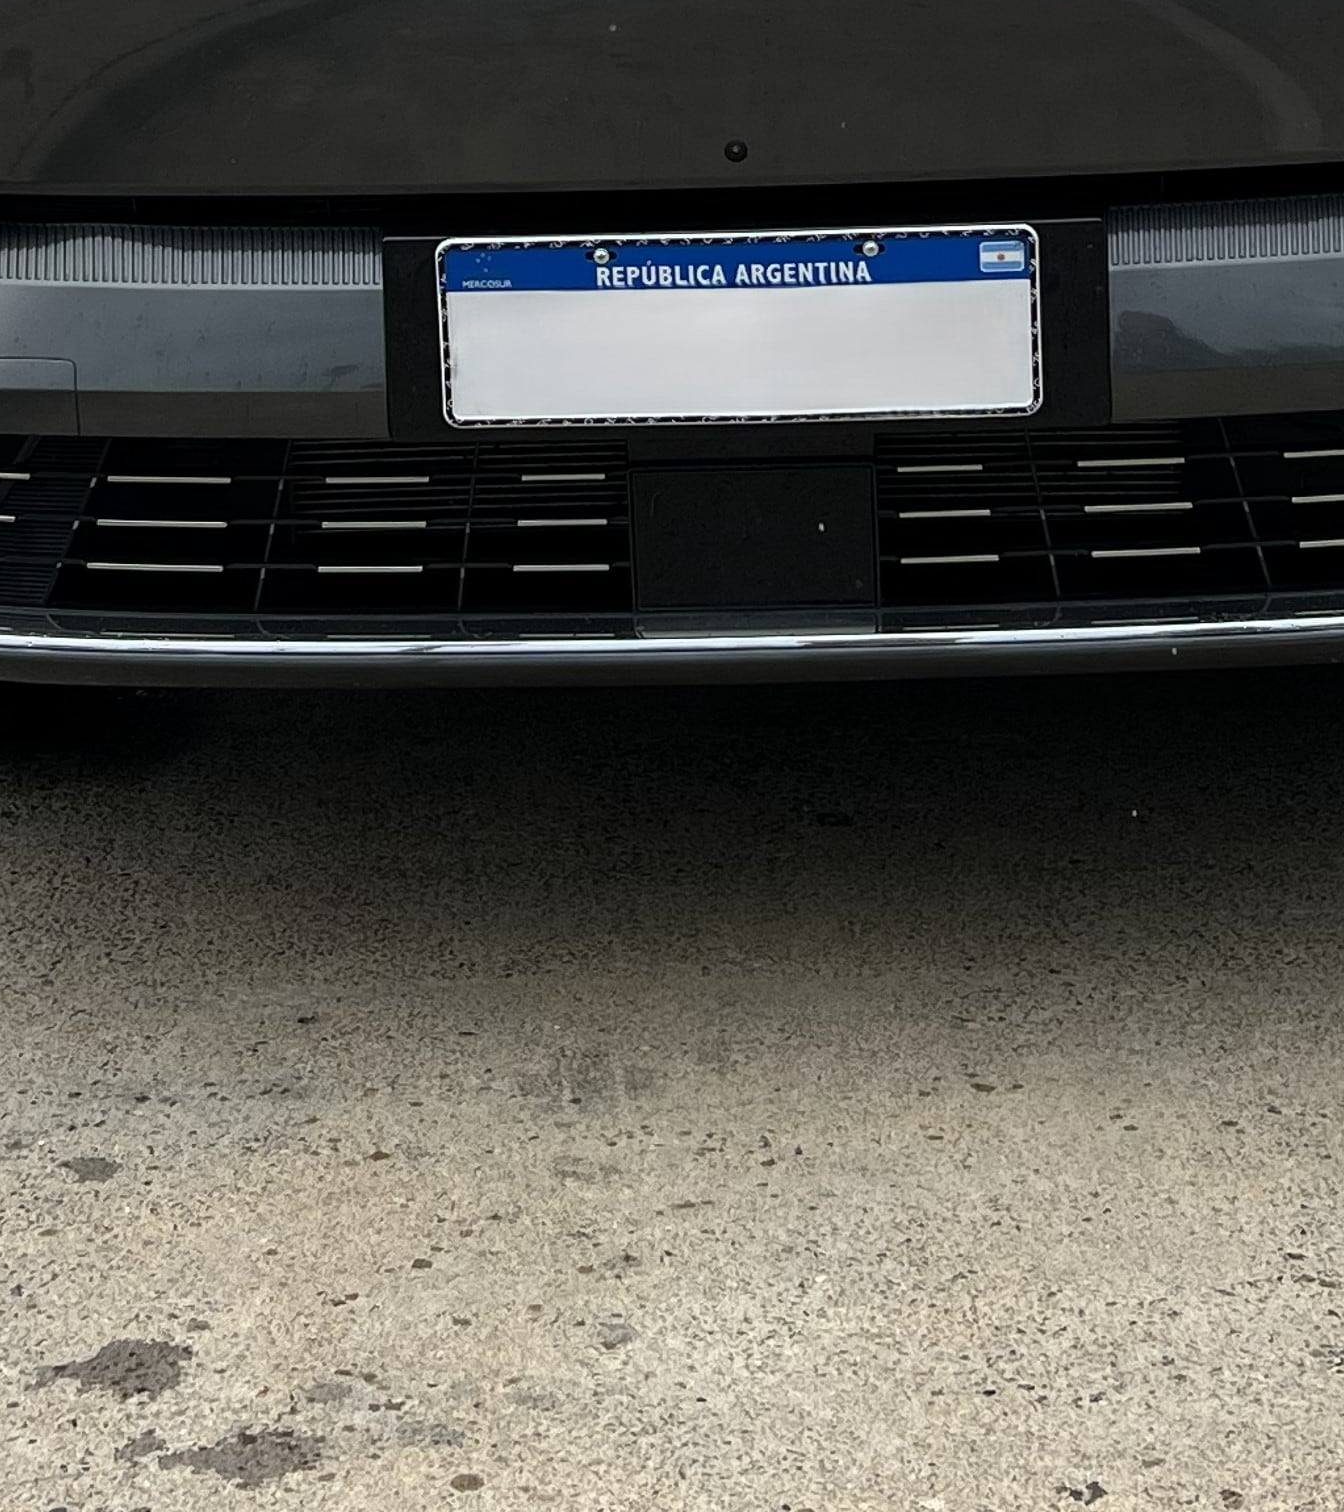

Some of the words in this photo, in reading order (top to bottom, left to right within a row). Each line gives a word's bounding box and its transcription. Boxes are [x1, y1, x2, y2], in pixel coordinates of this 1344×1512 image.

[595, 260, 727, 288] REPÚBLICA
[734, 260, 872, 285] ARGENTINA
[462, 279, 513, 289] MERCOSUR
